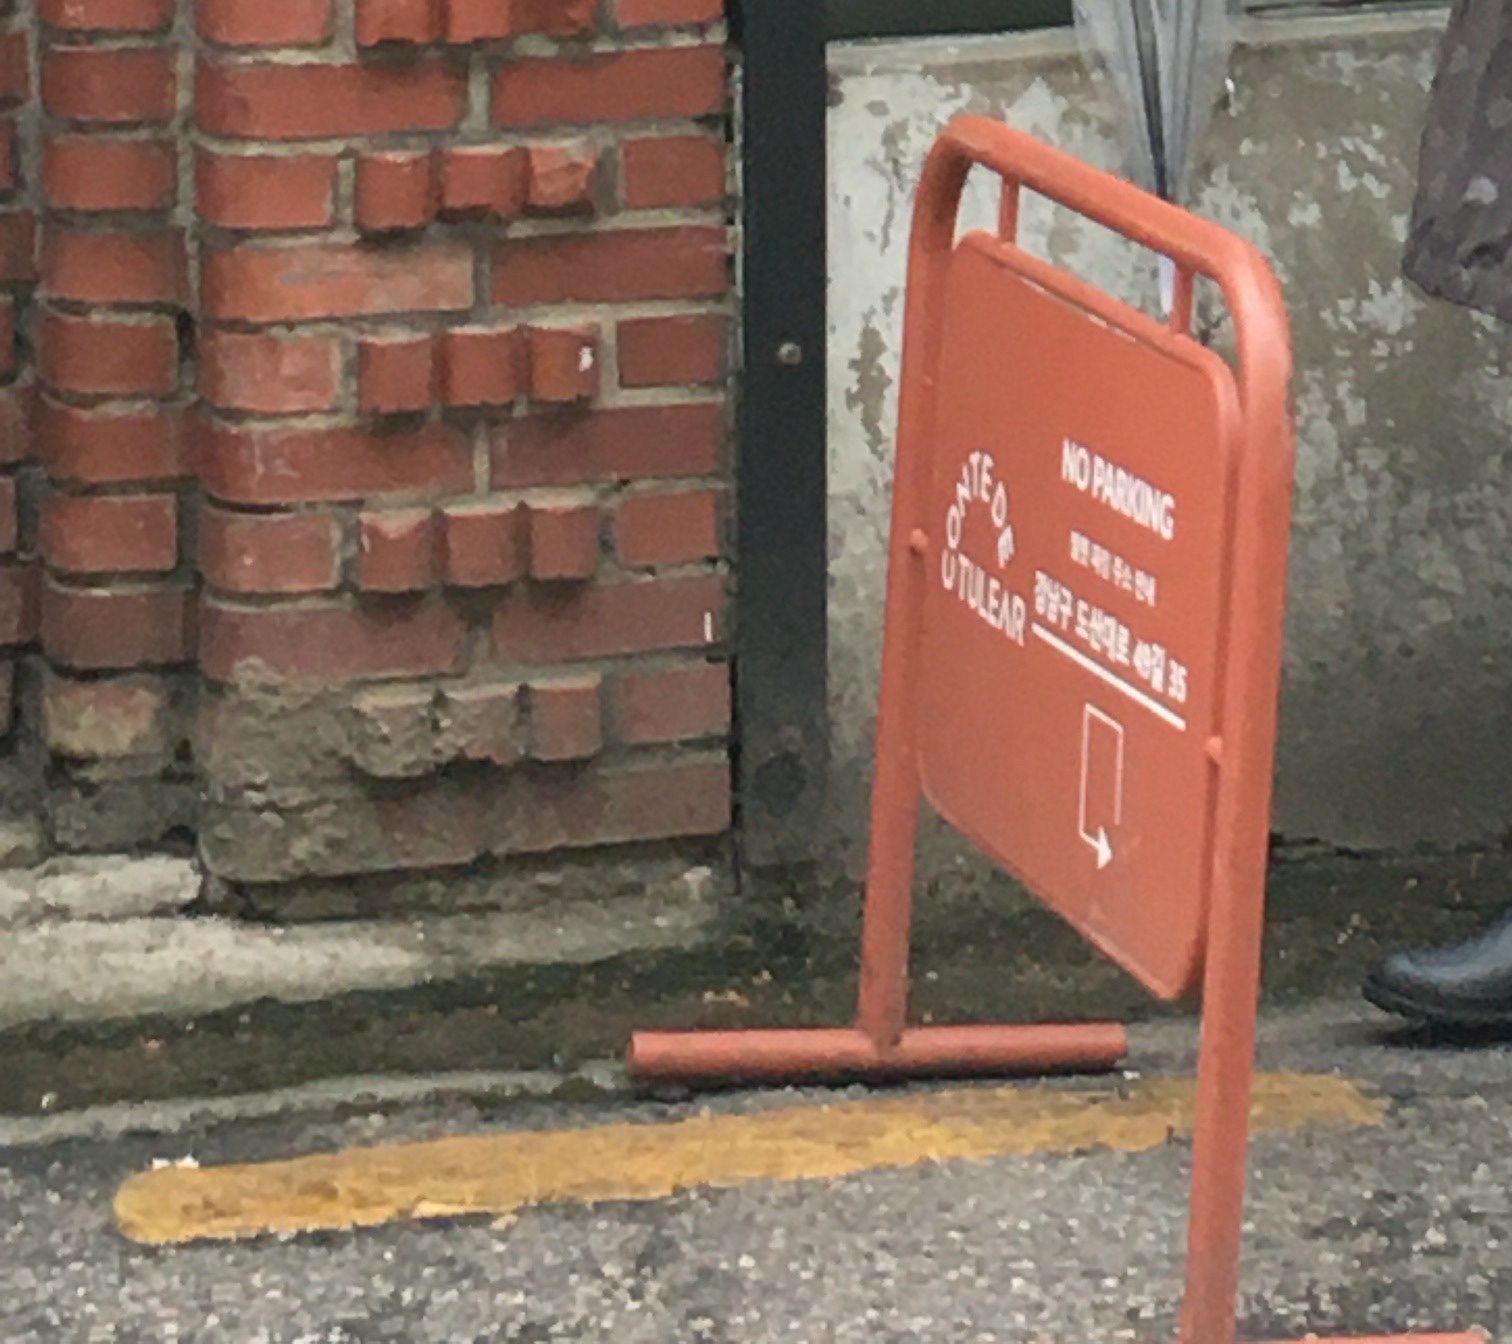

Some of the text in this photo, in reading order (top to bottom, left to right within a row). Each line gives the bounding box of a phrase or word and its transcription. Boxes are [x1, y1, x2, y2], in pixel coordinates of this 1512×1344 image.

[991, 480, 1015, 569] DE
[1062, 438, 1176, 541] NO PARKING
[1034, 569, 1073, 631] 강남구
[1074, 598, 1131, 666] 도산대로
[1168, 659, 1188, 704] 35
